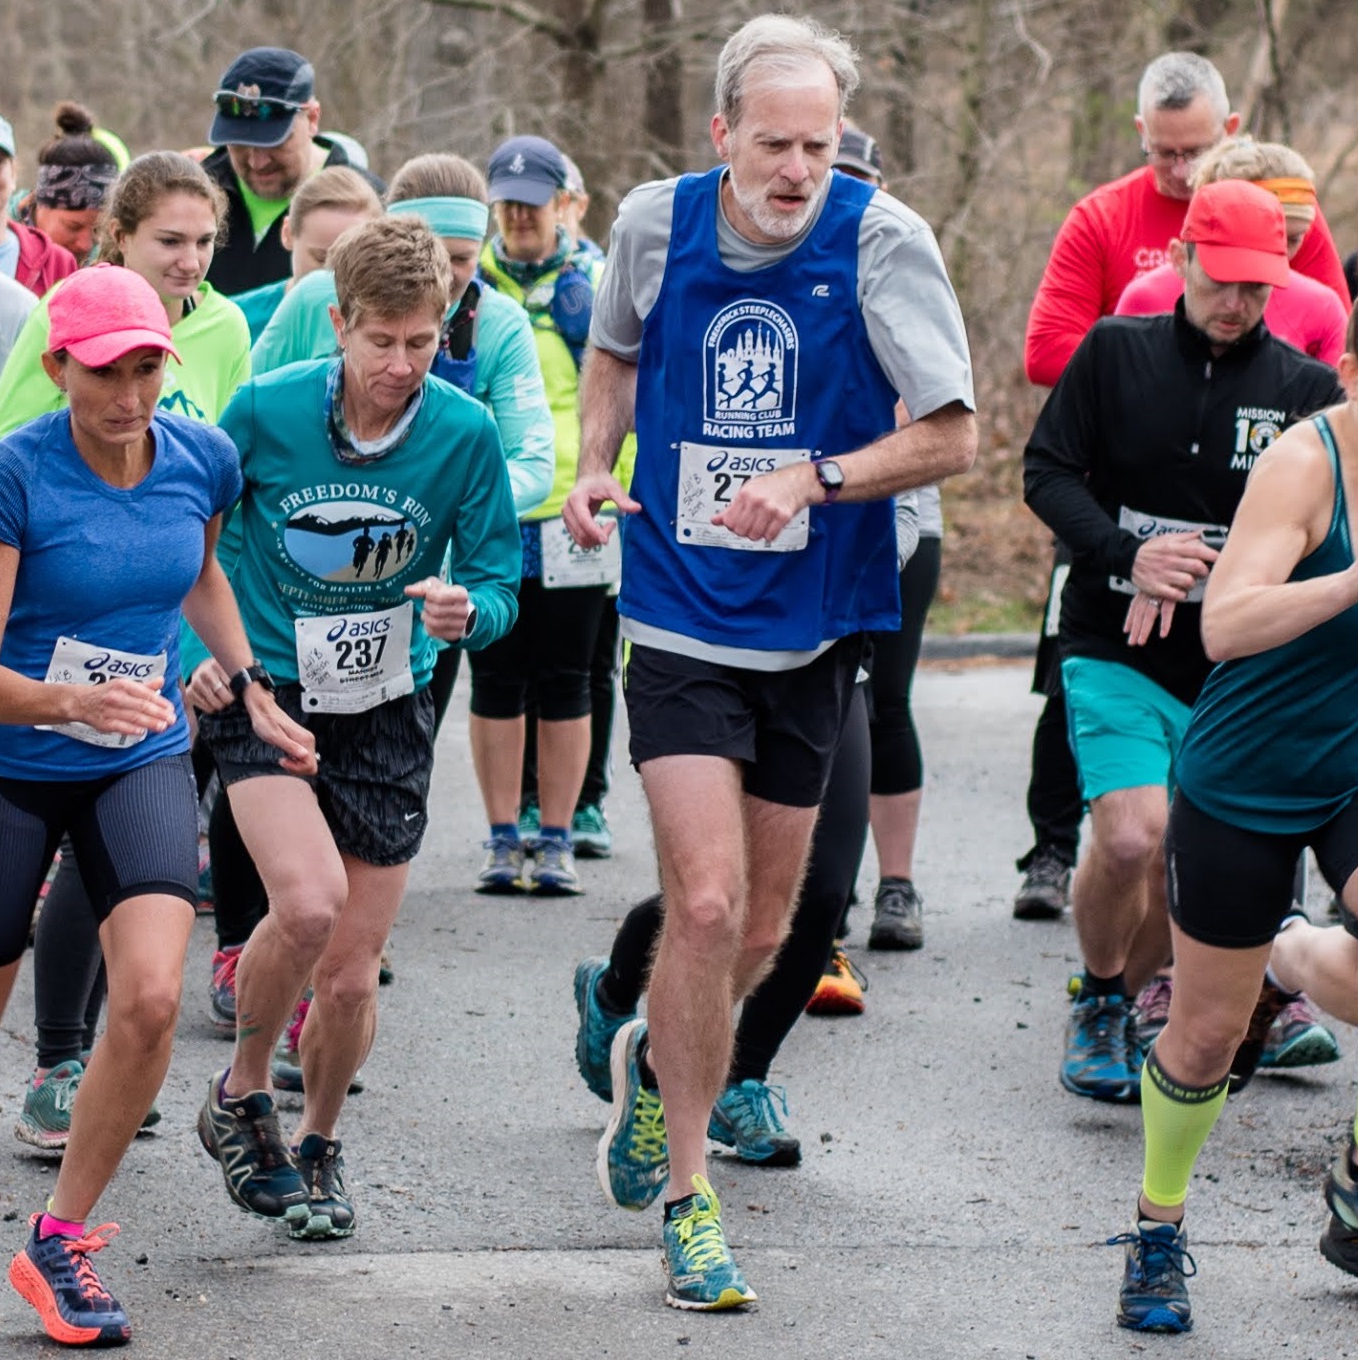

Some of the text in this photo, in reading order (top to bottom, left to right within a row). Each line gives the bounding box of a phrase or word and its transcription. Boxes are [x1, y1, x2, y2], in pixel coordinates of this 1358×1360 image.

[707, 305, 795, 350] FREDERICK STEEPLECHASERS
[715, 410, 782, 421] RUNNING CLUB
[1236, 407, 1286, 423] MISSION
[703, 422, 795, 439] RACING TEAM
[729, 457, 777, 472] asics
[279, 483, 432, 528] FREEDOM'S RUN
[329, 585, 372, 593] HEALTH
[325, 603, 375, 613] MARATHON
[349, 617, 391, 637] asics
[335, 634, 388, 670] 237
[107, 659, 154, 678] asics
